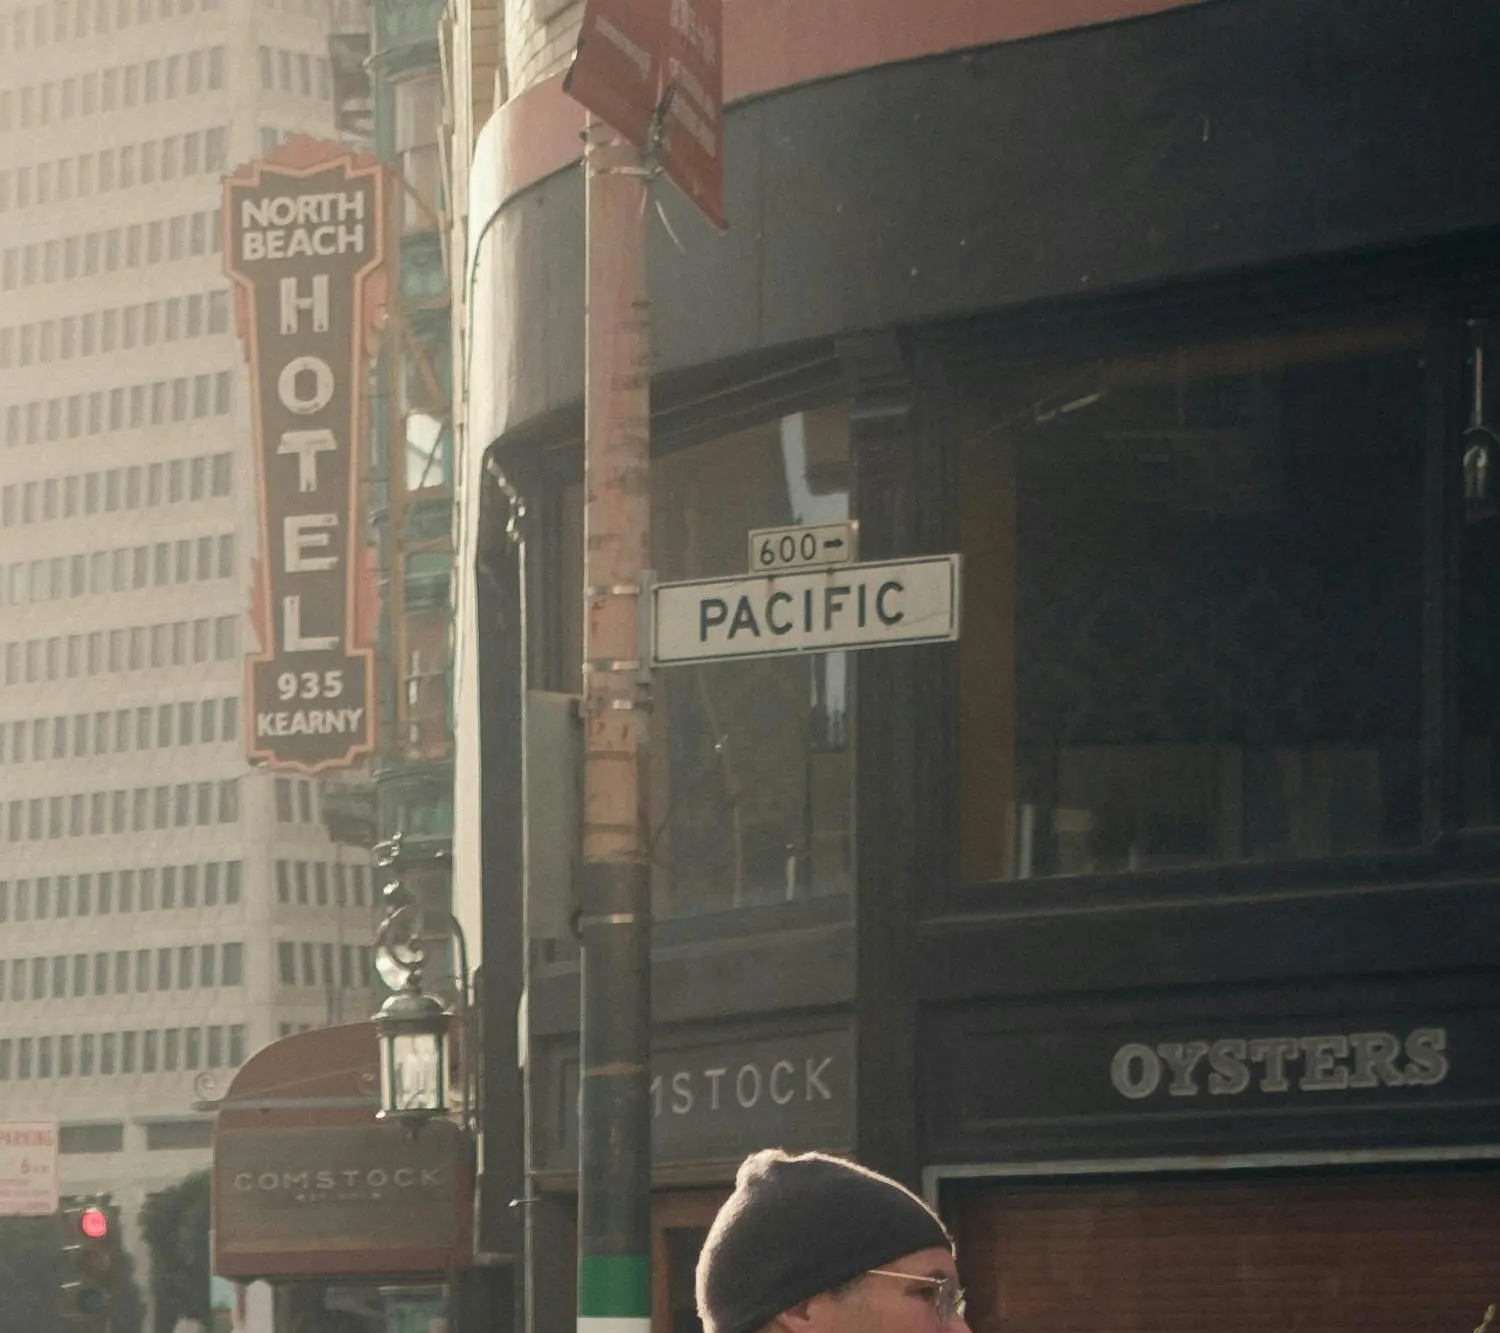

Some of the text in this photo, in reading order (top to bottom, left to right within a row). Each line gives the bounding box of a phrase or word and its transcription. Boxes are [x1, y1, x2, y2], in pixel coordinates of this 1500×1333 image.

[241, 191, 365, 228] NORTH
[242, 224, 365, 261] BEACH
[277, 274, 340, 652] HOTEL
[759, 533, 817, 566] 600
[699, 581, 905, 642] PACIFIC
[277, 671, 344, 701] 935
[257, 708, 364, 737] KEARNY
[1110, 1027, 1448, 1099] OYSTERS
[234, 1168, 441, 1192] COMSTOCK
